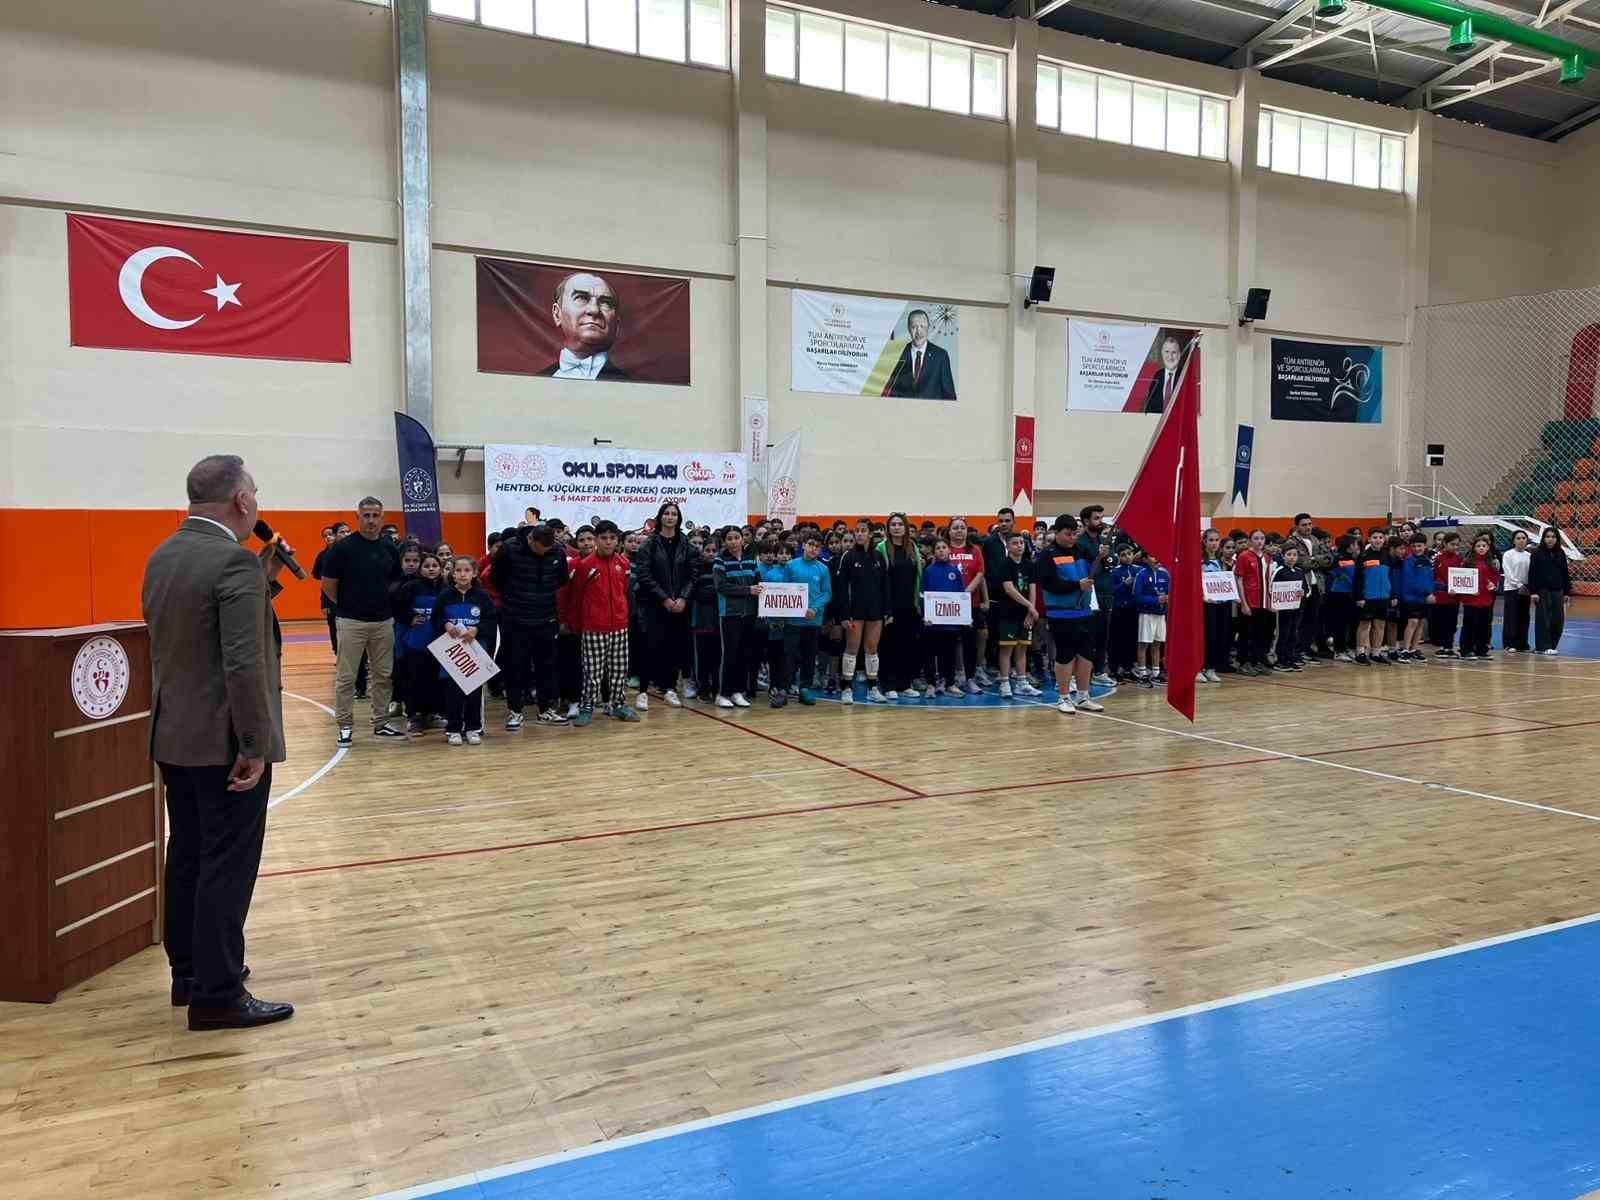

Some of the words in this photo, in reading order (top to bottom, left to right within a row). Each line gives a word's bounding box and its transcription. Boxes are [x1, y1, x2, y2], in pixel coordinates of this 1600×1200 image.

[606, 463, 678, 480] SPORLARI
[495, 483, 545, 493] HENTBOL
[547, 482, 600, 494] KÜÇÜKLER
[602, 485, 659, 496] (KIZ-ERKEK)
[660, 486, 686, 495] GRUP
[689, 487, 737, 497] YARIŞMASI
[567, 495, 592, 503] MART
[618, 496, 657, 504] KUŞADASI
[663, 496, 688, 504] AYDIN
[764, 594, 803, 609] ANTALYA
[935, 601, 961, 617] İZMİR
[445, 643, 480, 678] AYDIN
